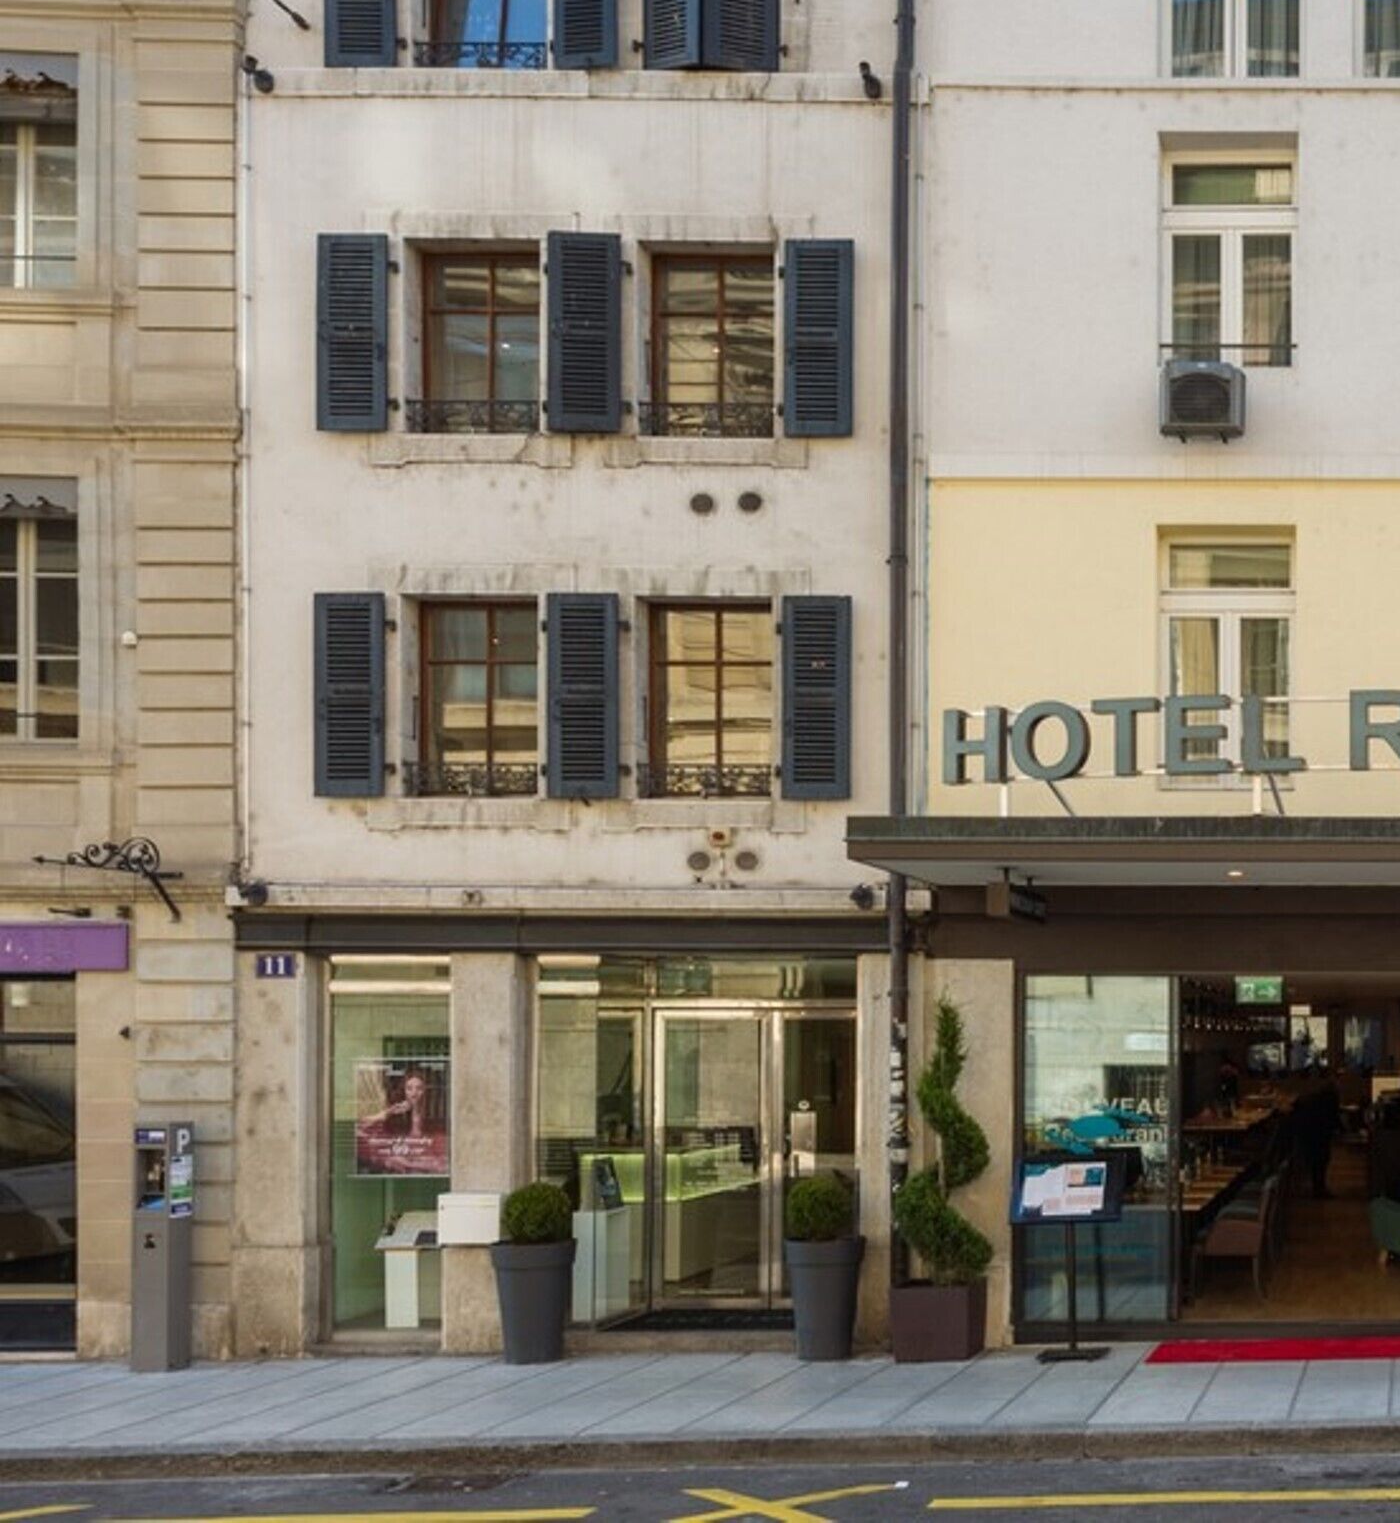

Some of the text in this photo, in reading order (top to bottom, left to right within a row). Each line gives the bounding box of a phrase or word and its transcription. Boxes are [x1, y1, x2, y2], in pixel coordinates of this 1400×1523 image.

[942, 693, 1307, 784] HOTEL
[264, 956, 285, 975] 11
[175, 1128, 191, 1154] P
